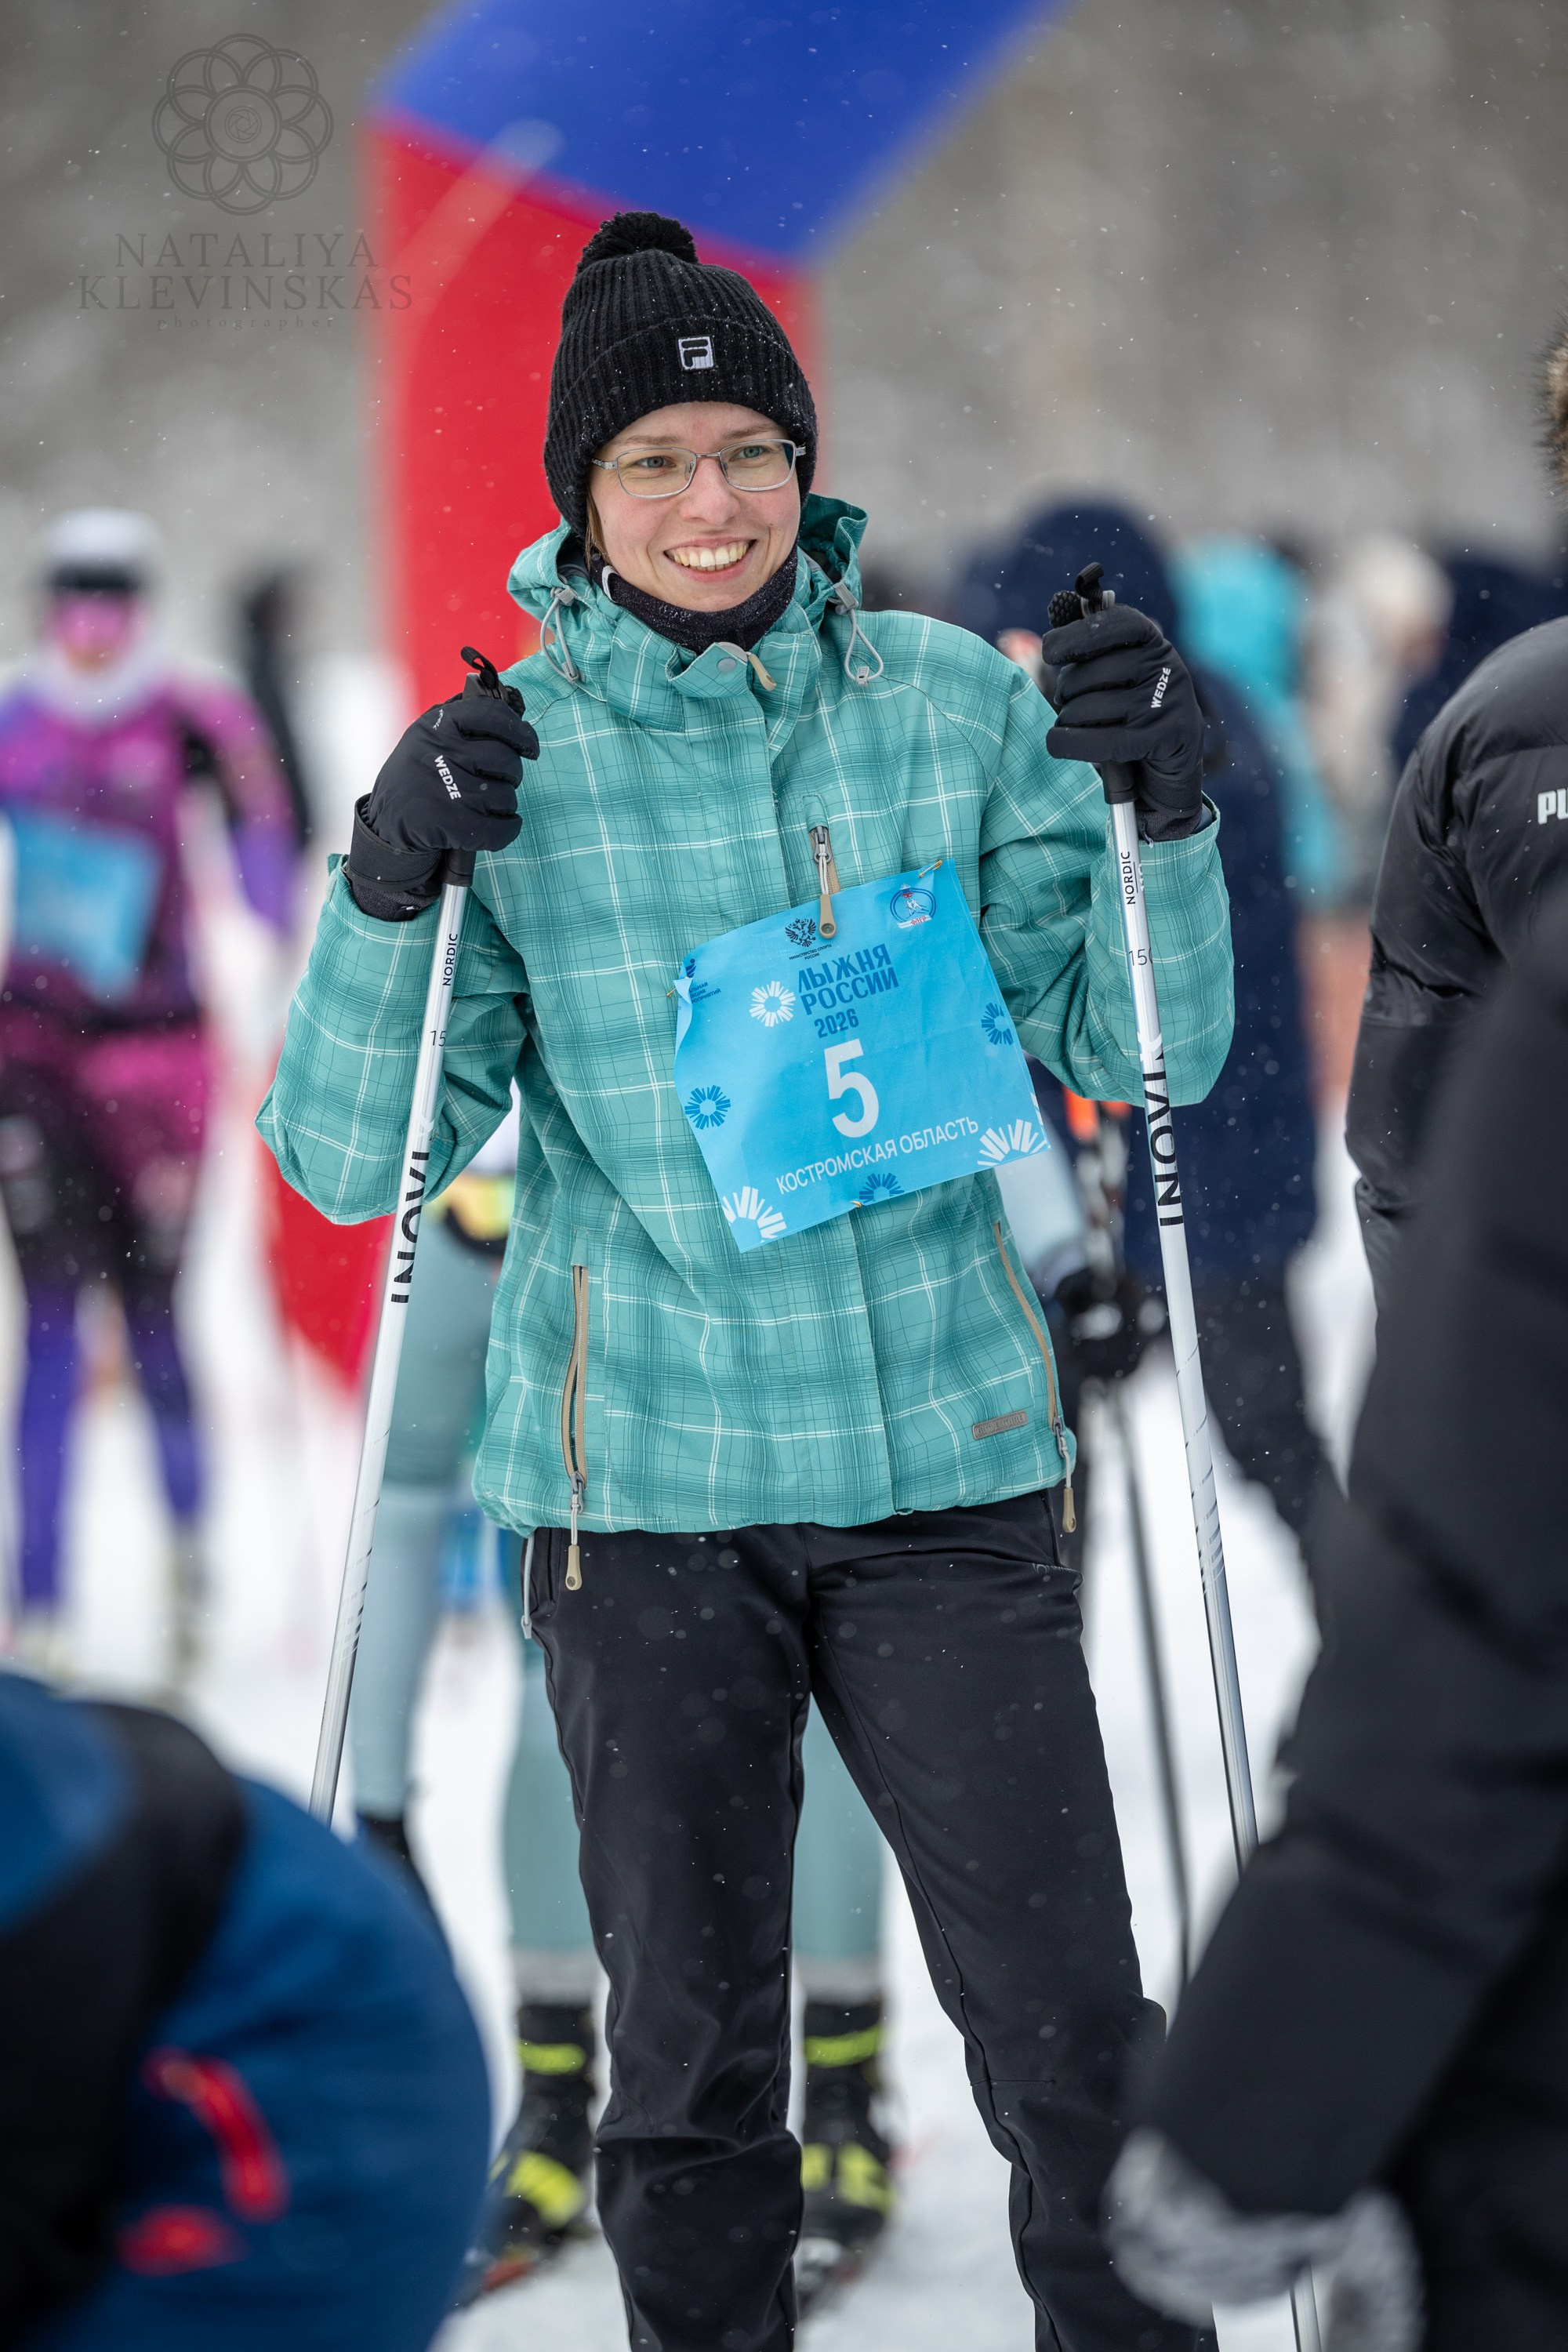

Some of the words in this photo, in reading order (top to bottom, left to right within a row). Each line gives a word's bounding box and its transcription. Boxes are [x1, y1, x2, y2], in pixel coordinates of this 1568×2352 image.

[1150, 667, 1171, 709] WEDZE
[434, 755, 462, 800] WEDZE
[1120, 851, 1136, 905] NORDIC
[442, 933, 459, 986] NORDIC
[789, 948, 818, 960] МИНИСТЕРСТВО
[817, 943, 833, 952] СПОРТА
[798, 943, 891, 993] ЛЫЖНЯ
[800, 967, 899, 1015] РОССИИ
[814, 1008, 859, 1039] 2026
[823, 1038, 880, 1138] 5
[776, 1139, 898, 1195] КОСТРОМСКАЯ
[900, 1116, 978, 1154] ОБЛАСТЬ
